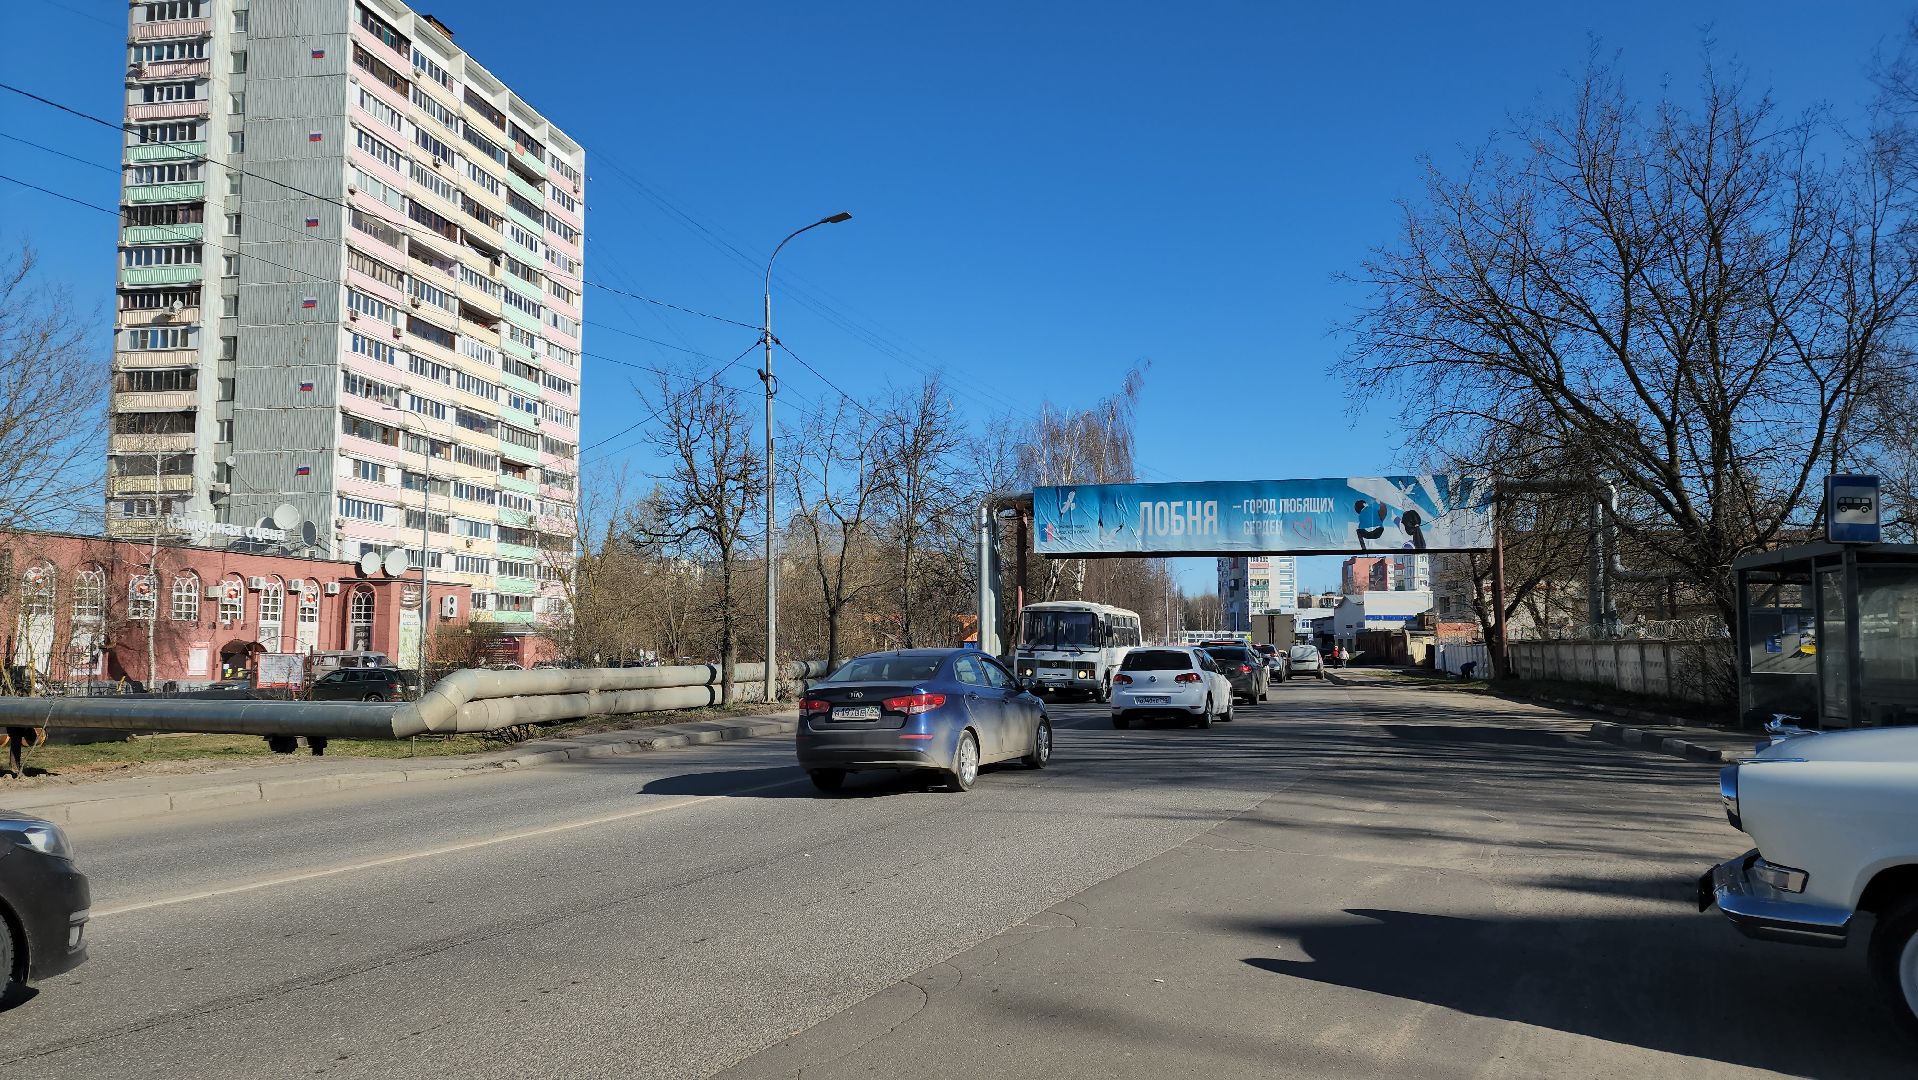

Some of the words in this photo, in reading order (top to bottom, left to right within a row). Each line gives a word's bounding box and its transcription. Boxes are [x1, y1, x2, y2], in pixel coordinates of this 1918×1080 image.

[1137, 500, 1218, 536] ЛОБНЯ
[1243, 498, 1277, 515] ГОРОД
[1279, 497, 1335, 514] ЛЮБЯЩИХ
[167, 513, 242, 537] Камерная
[245, 526, 286, 541] сцена
